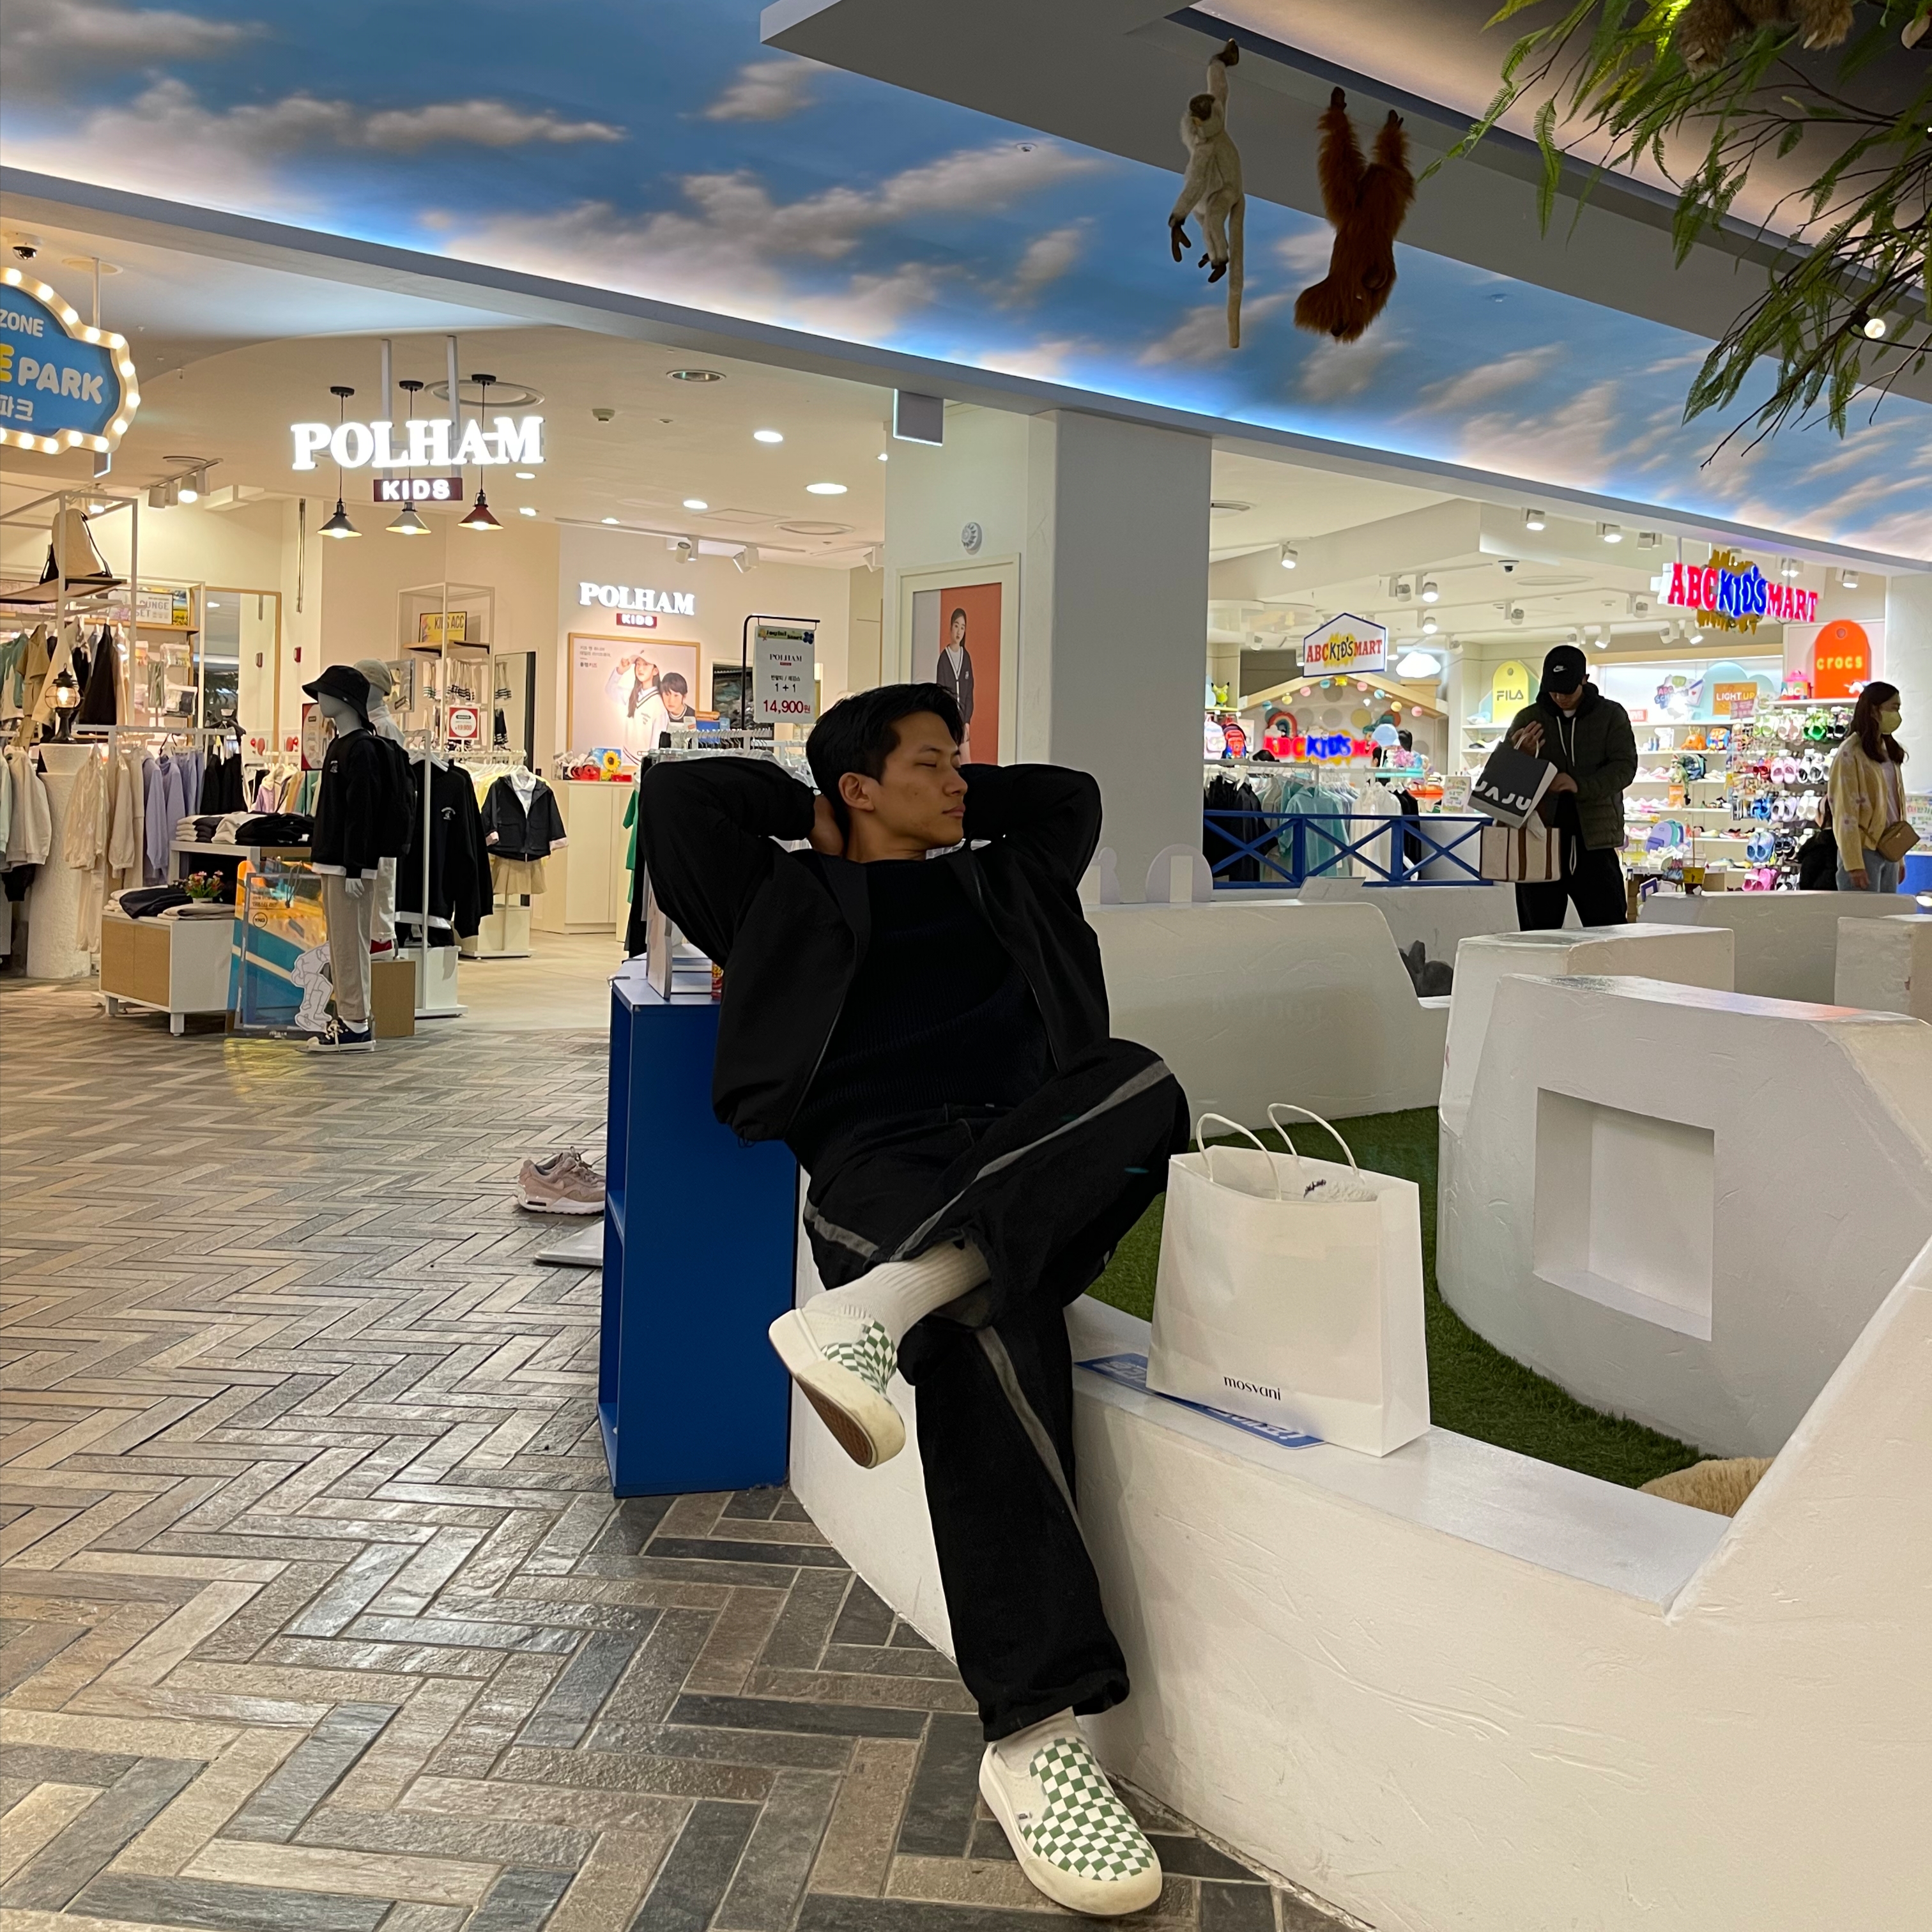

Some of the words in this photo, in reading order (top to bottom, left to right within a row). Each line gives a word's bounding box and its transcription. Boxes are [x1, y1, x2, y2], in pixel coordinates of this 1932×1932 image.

[18, 356, 103, 404] PARK
[290, 417, 546, 470] POLHAM
[382, 479, 451, 500] KIDS
[579, 582, 695, 616] POLHAM
[621, 614, 654, 627] KIDS
[770, 654, 802, 662] POLHAM
[1816, 656, 1862, 670] crocs
[1497, 689, 1524, 701] FILA
[1716, 692, 1742, 701] LIGHT
[1781, 687, 1800, 696] ABC
[1475, 780, 1533, 811] JAJU
[1223, 1376, 1280, 1400] mosvani
